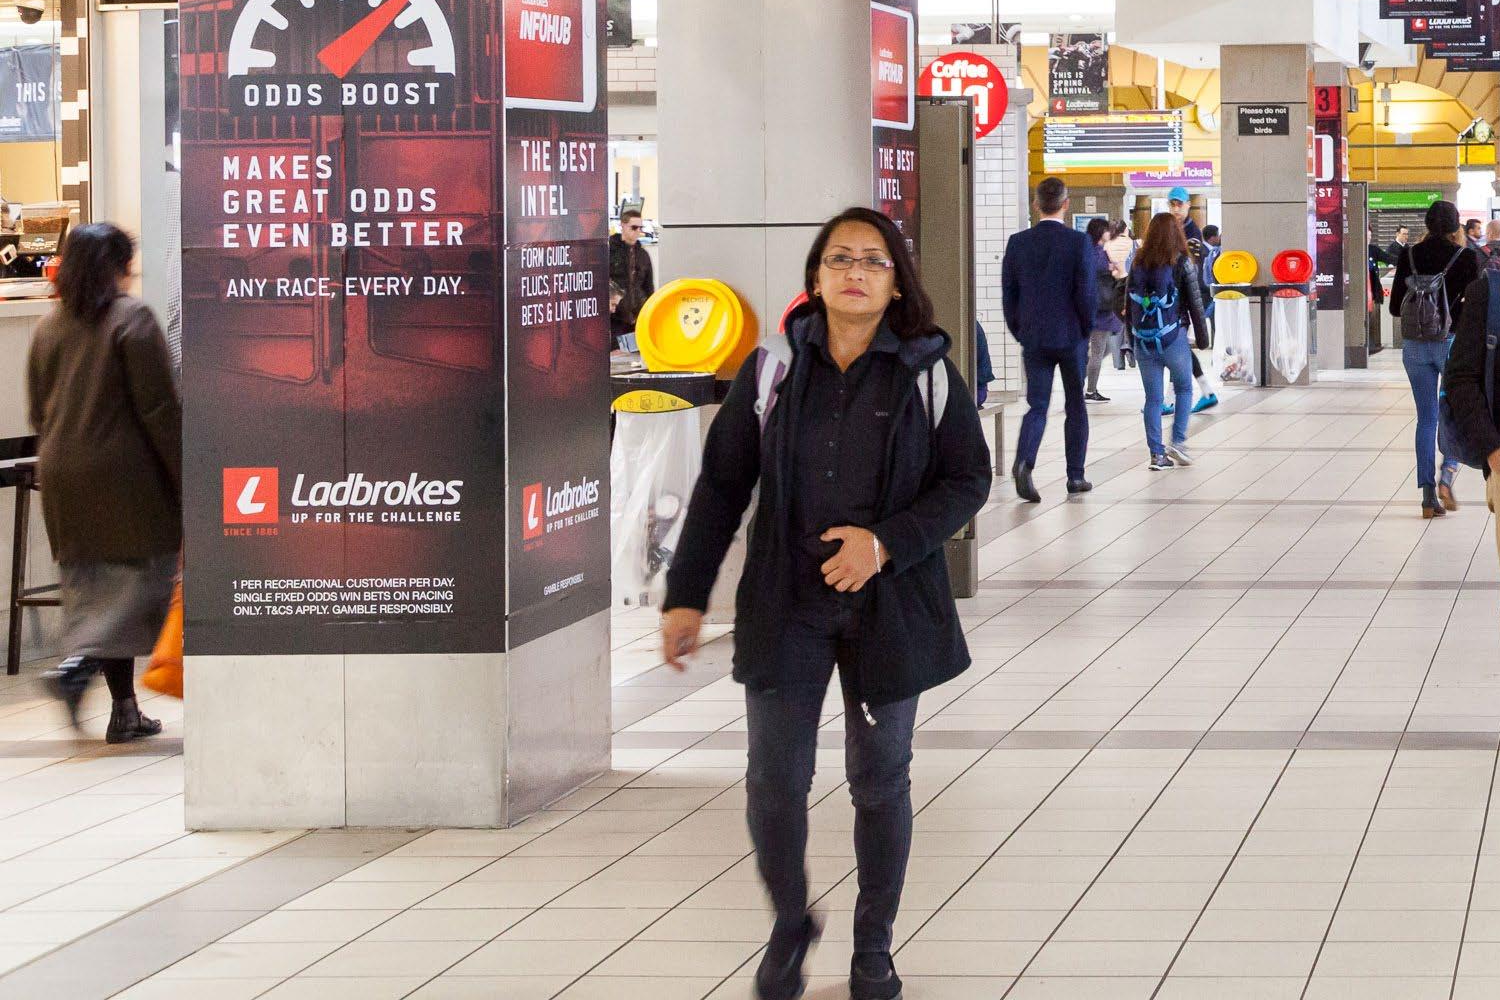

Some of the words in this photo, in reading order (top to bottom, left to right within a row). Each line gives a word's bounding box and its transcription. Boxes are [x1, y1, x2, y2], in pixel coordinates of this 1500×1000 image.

[520, 10, 572, 45] INFOHUB
[931, 60, 989, 78] Coffee
[16, 82, 46, 103] THIS
[244, 84, 322, 106] ODDS
[342, 82, 439, 105] BOOST
[1240, 107, 1262, 115] Please
[1264, 107, 1274, 115] do
[1275, 107, 1287, 115] not
[1249, 117, 1263, 125] feed
[1265, 117, 1277, 125] the
[1254, 126, 1273, 134] birds
[223, 155, 332, 180] MAKES
[521, 140, 551, 172] THE
[559, 141, 597, 172] BEST
[879, 148, 894, 170] THE
[896, 149, 915, 172] BEST
[521, 185, 568, 216] INTEL
[879, 178, 902, 200] INTEL
[223, 189, 328, 214] GREAT
[350, 188, 436, 212] ODDS
[223, 223, 309, 248] EVEN
[331, 222, 463, 247] BETTER
[521, 248, 544, 268] FORM
[547, 245, 572, 267] GUIDE,
[226, 278, 267, 297] ANY
[277, 277, 336, 298] RACE,
[346, 277, 413, 296] EVERY
[423, 276, 465, 295] DAY.
[521, 276, 551, 297] FLUCS,
[554, 271, 593, 294] FEATURED
[522, 304, 544, 326] BETS
[555, 300, 573, 321] LIVE
[575, 297, 599, 319] VIDEO.
[291, 472, 463, 506] Ladbrokes
[546, 476, 600, 517] Ladbrokes
[292, 513, 308, 523] UP
[316, 513, 341, 523] FOR
[349, 512, 374, 522] THE
[381, 511, 461, 522] CHALLENGE
[232, 580, 237, 589] 1
[241, 580, 262, 589] PER
[264, 579, 344, 589] RECREATIONAL
[346, 578, 406, 588] CUSTOMER
[409, 578, 430, 587] PER
[433, 578, 455, 587] DAY.
[234, 592, 272, 602] SINGLE
[275, 592, 305, 602] FIXED
[307, 591, 338, 602] ODDS
[340, 592, 361, 601] WIN
[363, 591, 391, 601] BETS
[393, 591, 409, 600] ON
[412, 590, 453, 600] RACING
[233, 606, 263, 616] ONLY.
[265, 605, 293, 615] T&CS
[295, 605, 329, 615] APPLY.
[332, 604, 377, 614] GAMBLE
[379, 604, 453, 614] RESPONSIBLY.
